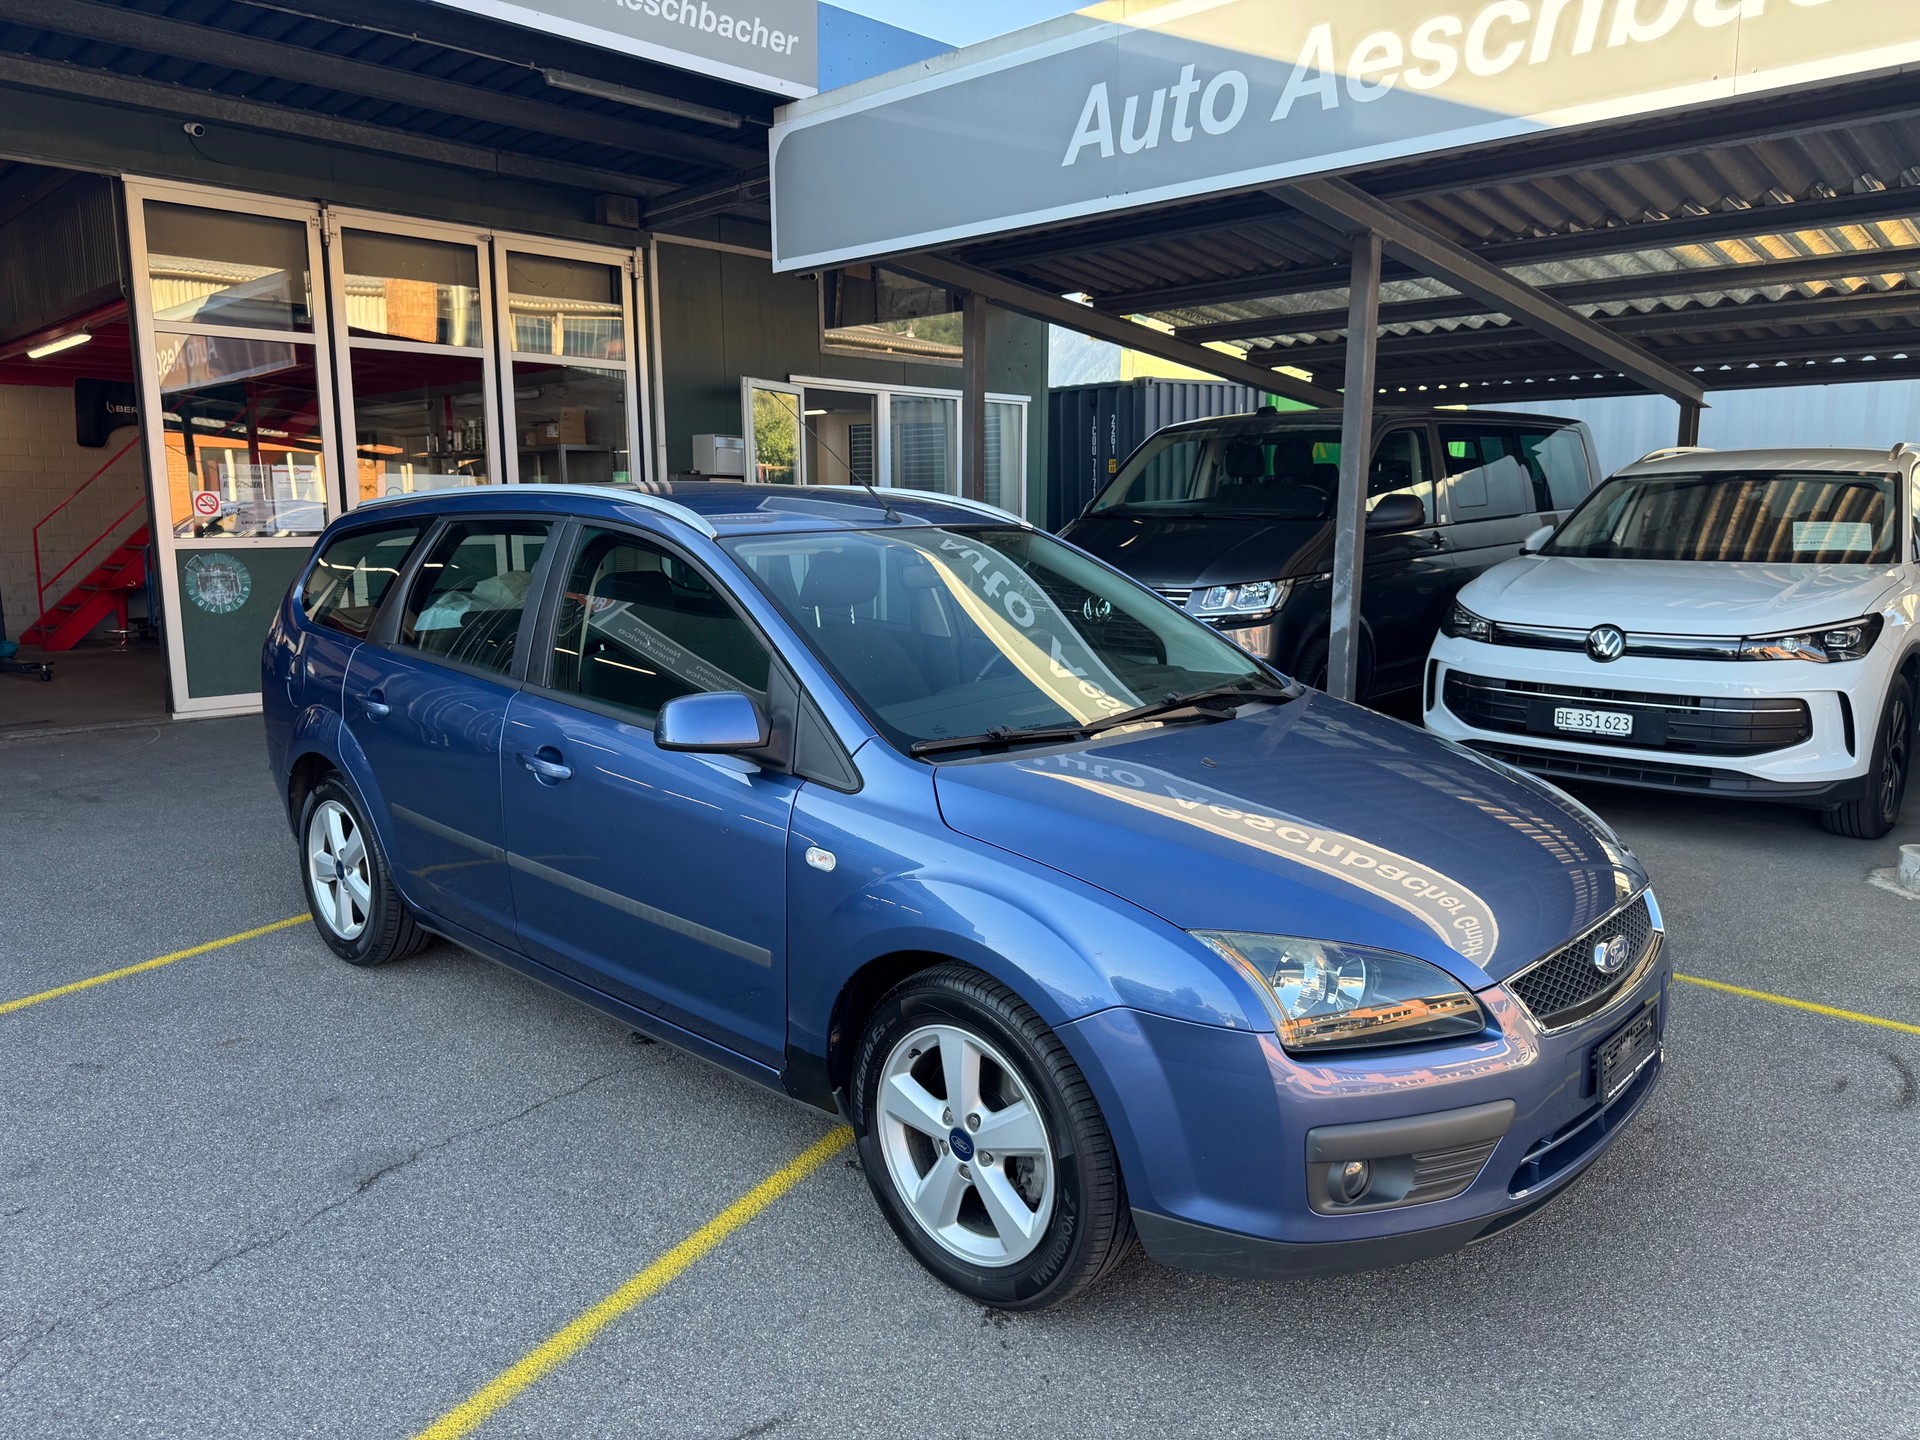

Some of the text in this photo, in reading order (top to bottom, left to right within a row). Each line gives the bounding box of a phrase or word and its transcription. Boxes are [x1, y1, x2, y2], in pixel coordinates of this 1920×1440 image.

[602, 0, 799, 55] eschbacher
[1060, 63, 1249, 168] Auto
[1610, 943, 1626, 966] Ford
[1030, 1214, 1075, 1286] YOKOHAMA
